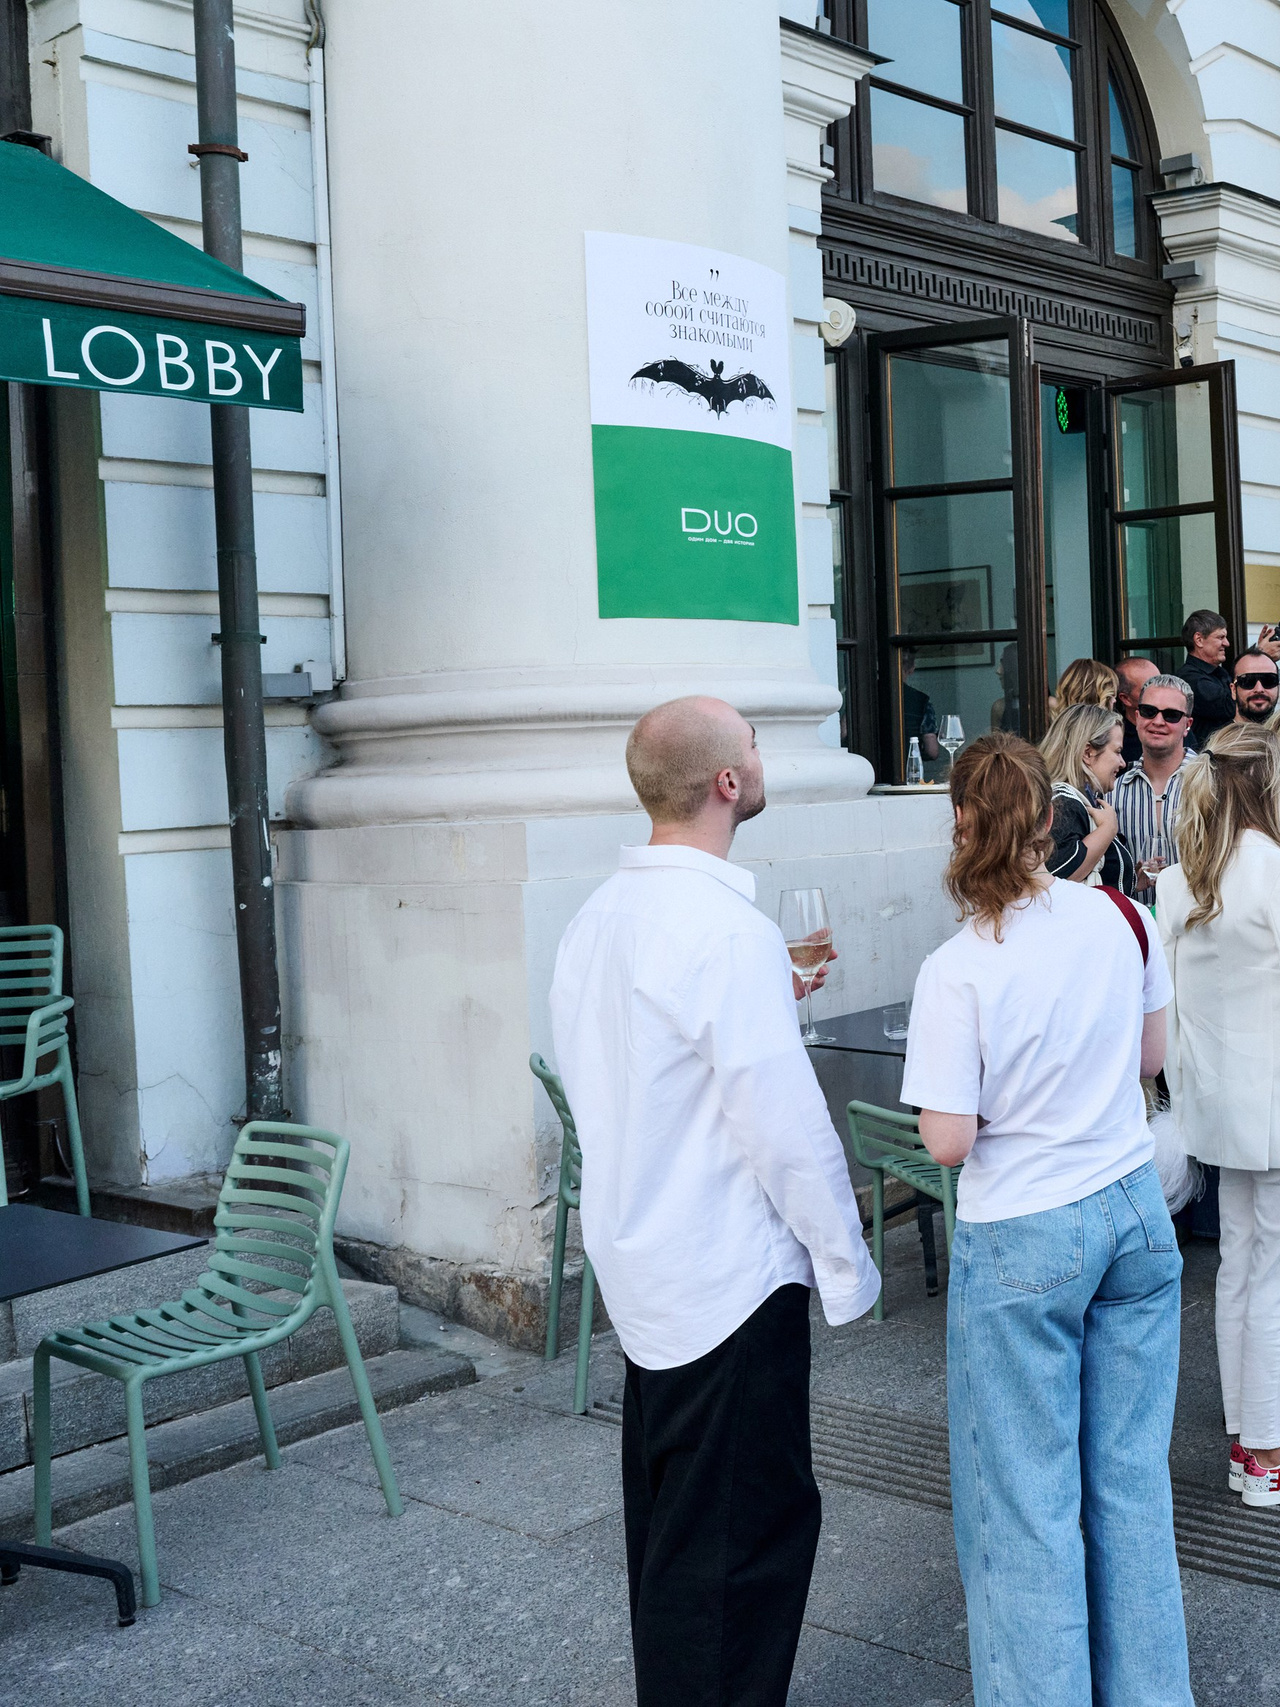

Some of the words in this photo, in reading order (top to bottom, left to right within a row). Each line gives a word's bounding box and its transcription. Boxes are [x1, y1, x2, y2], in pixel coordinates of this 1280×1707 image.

[671, 280, 698, 303] Все
[703, 290, 750, 318] между
[645, 300, 694, 322] собой
[699, 309, 766, 339] считаются
[668, 323, 753, 353] знакомыми
[42, 317, 283, 401] LOBBY
[681, 507, 758, 538] DUO
